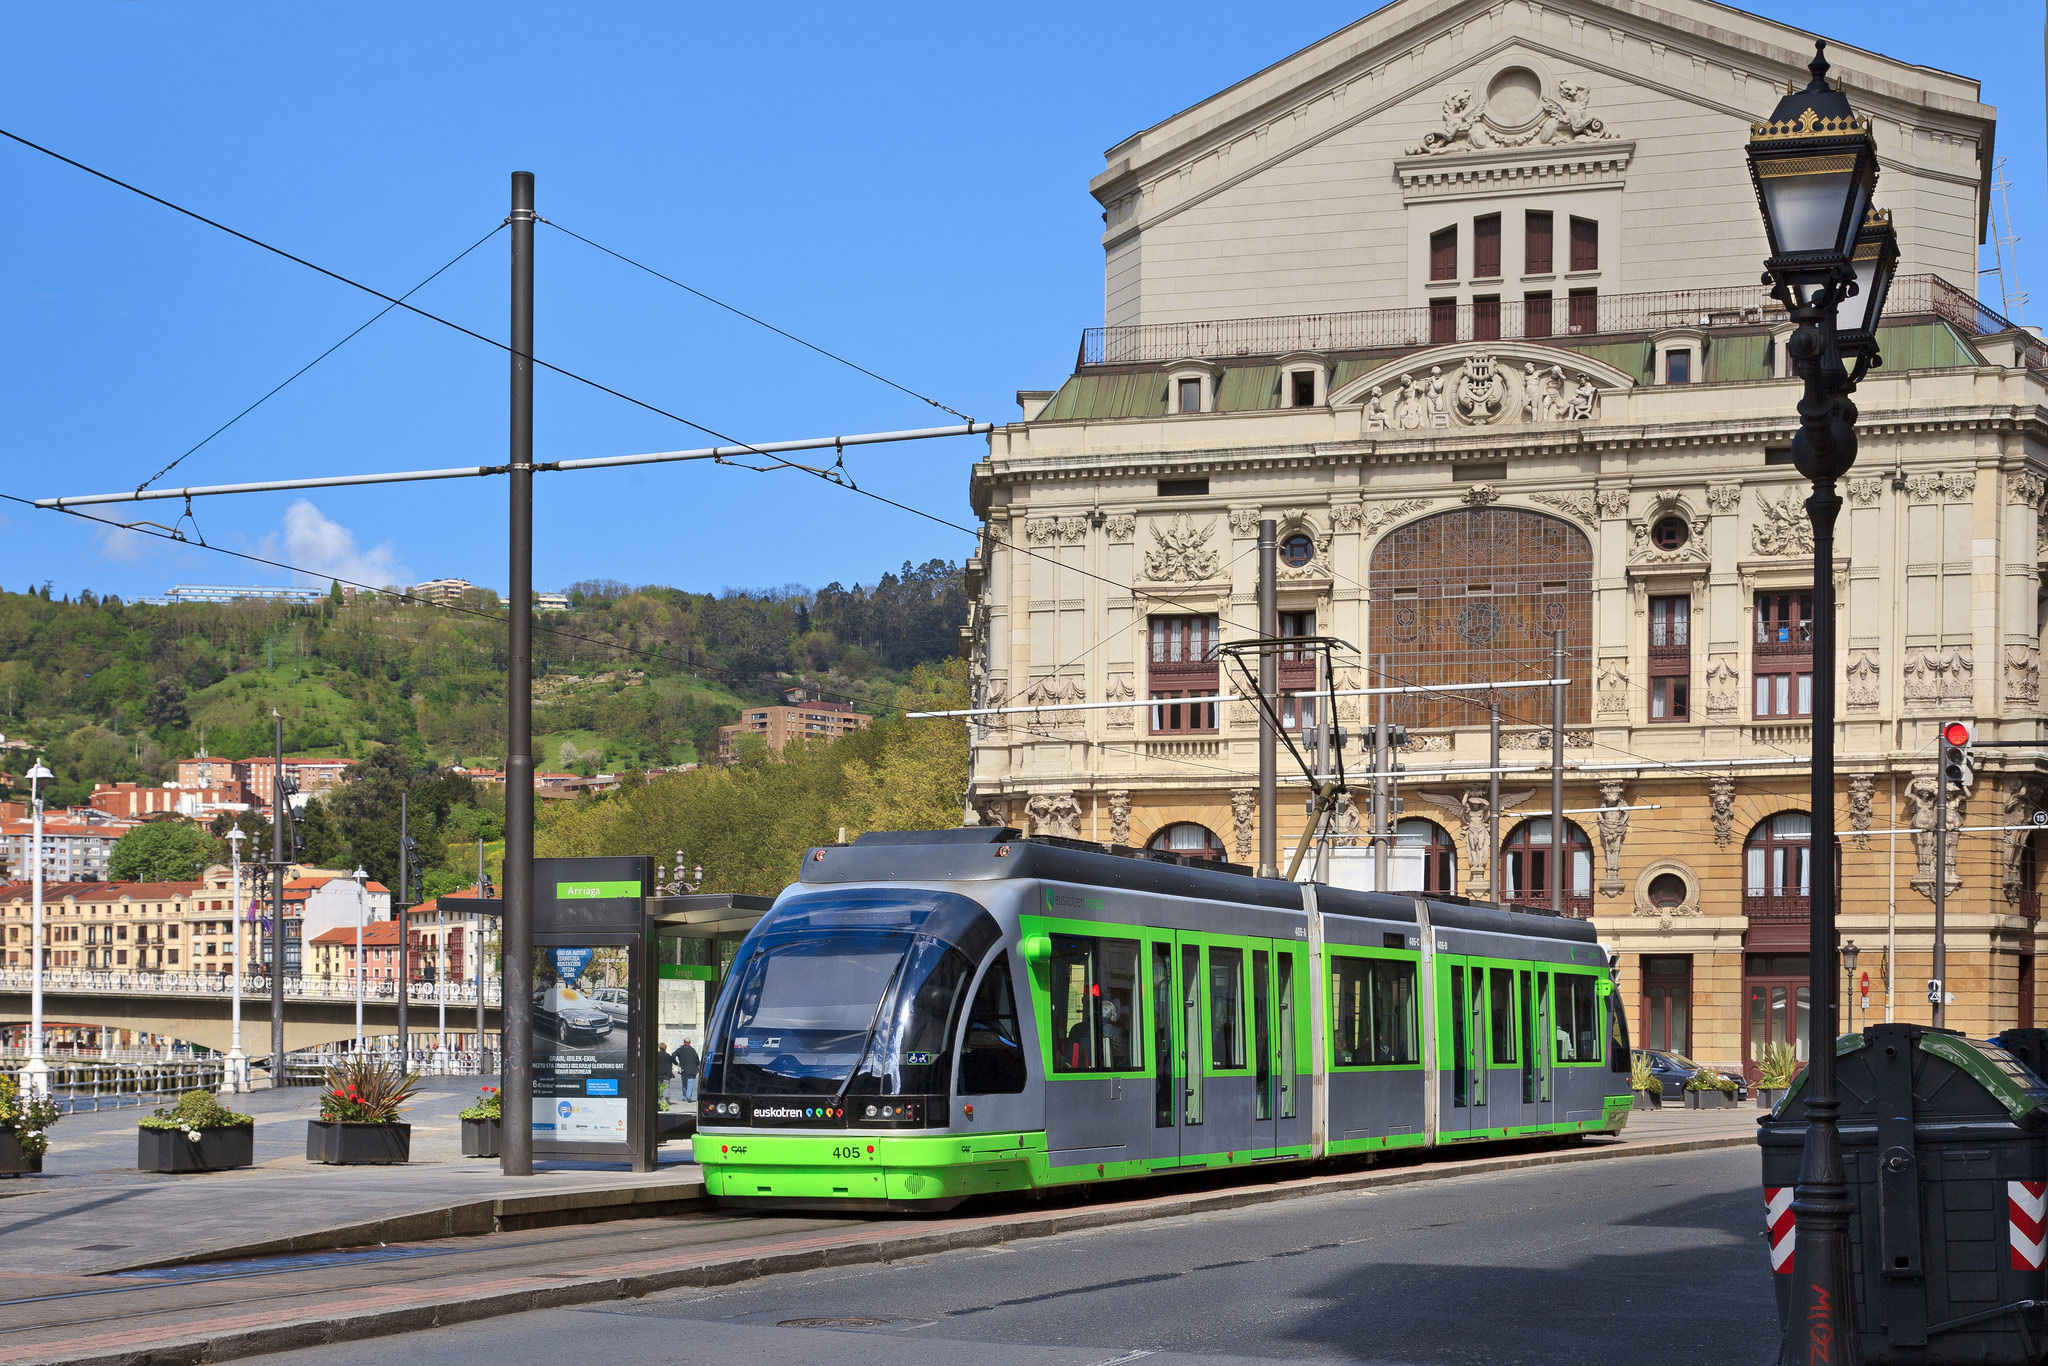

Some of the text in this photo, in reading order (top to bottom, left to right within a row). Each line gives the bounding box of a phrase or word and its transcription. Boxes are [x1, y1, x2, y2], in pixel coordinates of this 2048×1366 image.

[567, 886, 600, 898] Arriaga
[1294, 926, 1307, 937] 405-A
[1408, 936, 1420, 947] 405-C
[753, 1107, 803, 1118] euskotren
[731, 1145, 748, 1154] CAF
[832, 1146, 861, 1159] 405
